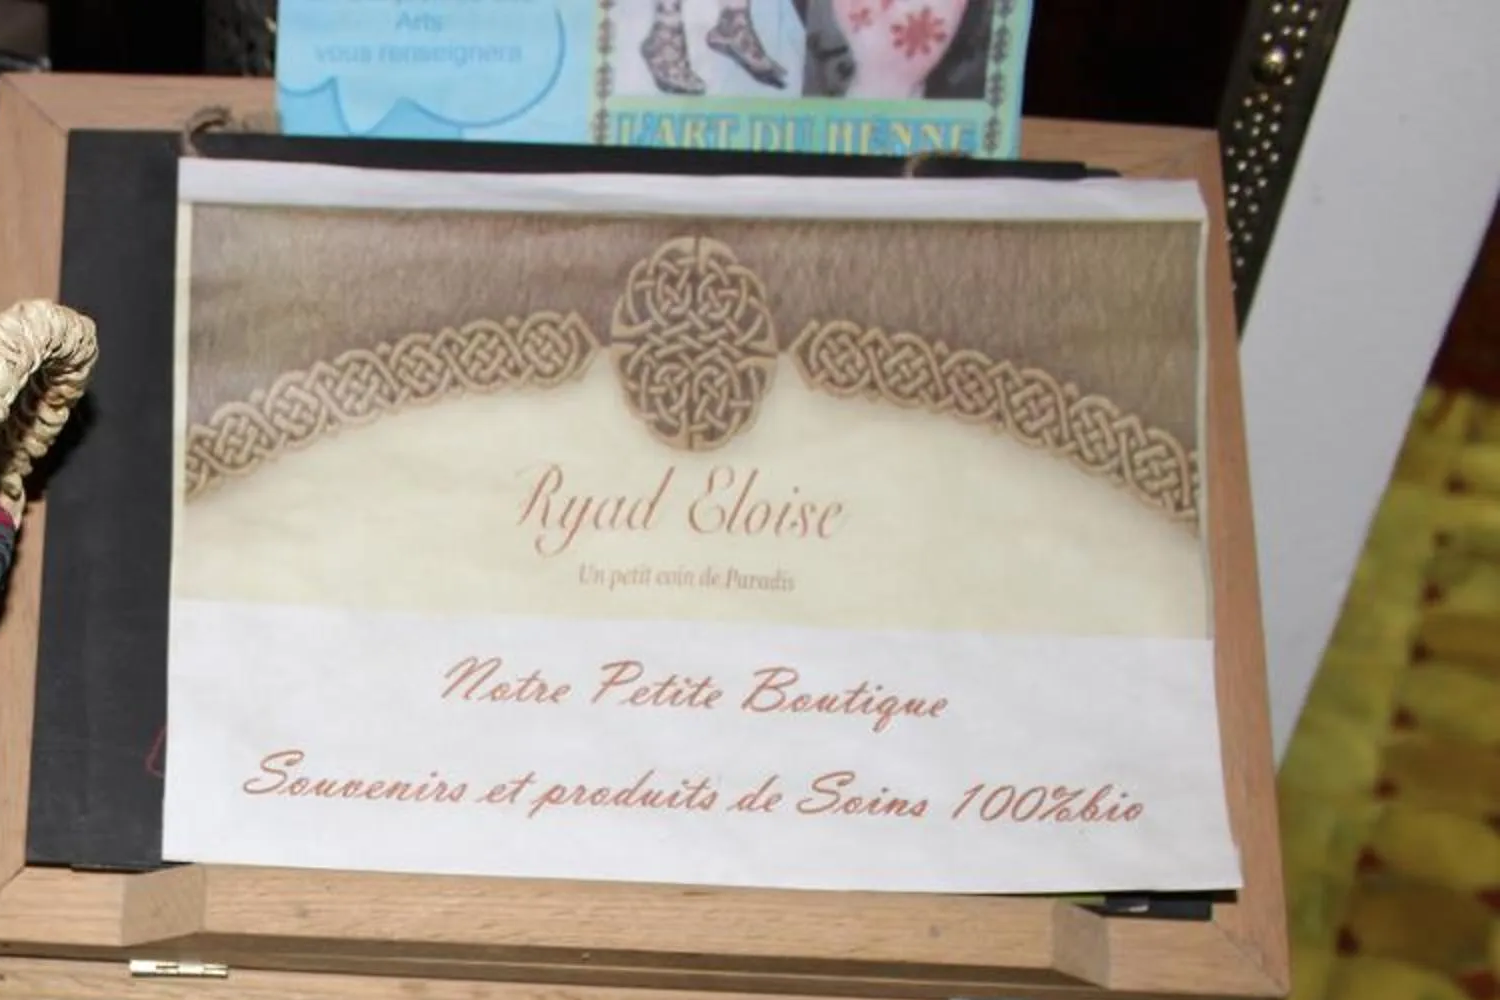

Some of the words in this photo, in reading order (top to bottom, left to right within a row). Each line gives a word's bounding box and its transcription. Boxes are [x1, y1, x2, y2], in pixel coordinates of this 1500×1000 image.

[395, 11, 444, 32] Arts
[514, 462, 676, 558] Ryad
[688, 465, 844, 540] Eloise
[578, 563, 606, 586] Un
[609, 564, 651, 592] petit
[655, 565, 696, 588] coin
[699, 566, 720, 587] de
[725, 563, 796, 592] Paradis
[441, 655, 572, 702] Notre
[591, 659, 725, 710] Petite
[740, 666, 949, 733] Boutique
[243, 749, 468, 804] Souvenirs
[474, 771, 536, 805] et
[527, 769, 720, 818] produits
[726, 774, 784, 814] de
[796, 771, 929, 819] Soins
